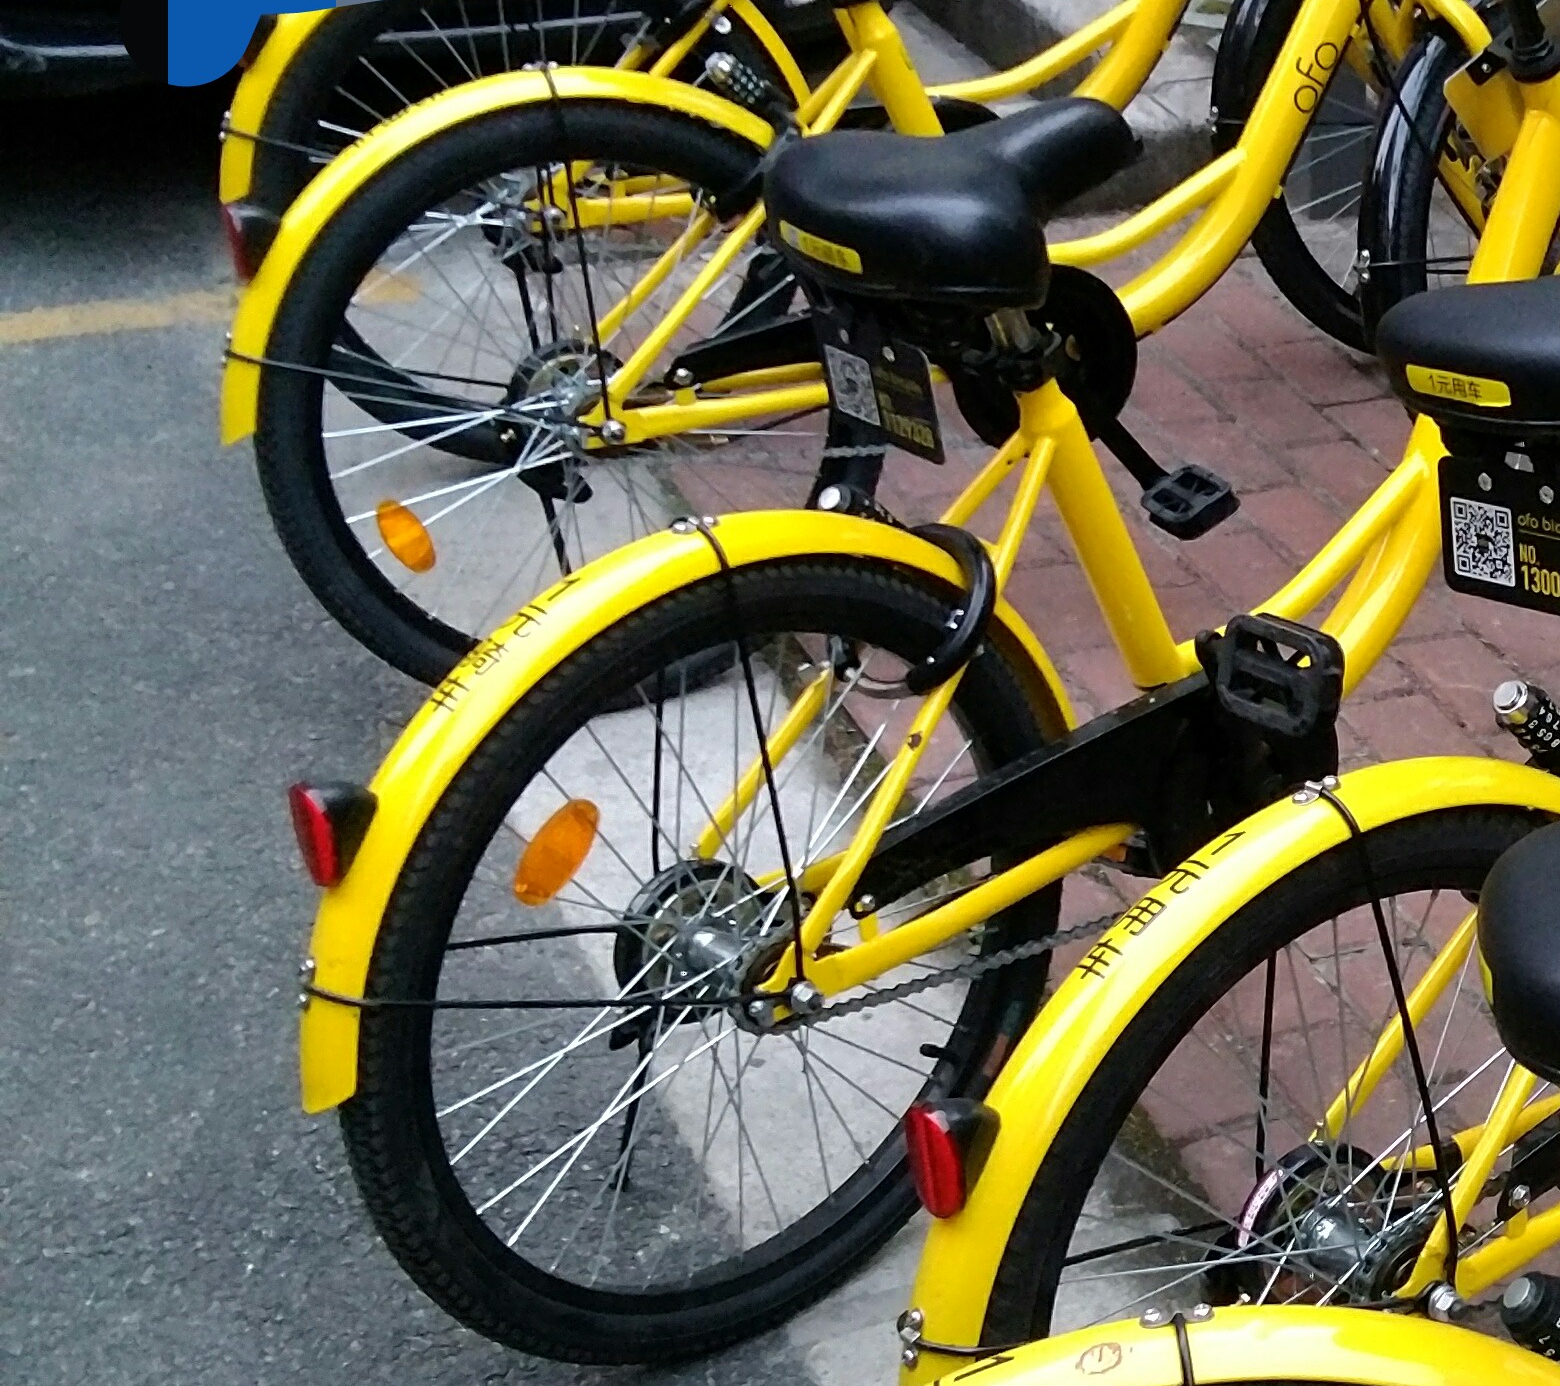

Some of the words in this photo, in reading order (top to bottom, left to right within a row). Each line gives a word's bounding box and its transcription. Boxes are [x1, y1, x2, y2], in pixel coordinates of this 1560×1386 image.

[1292, 41, 1340, 114] ofo
[1517, 513, 1539, 530] ofo
[1076, 830, 1247, 980] 1元用车
